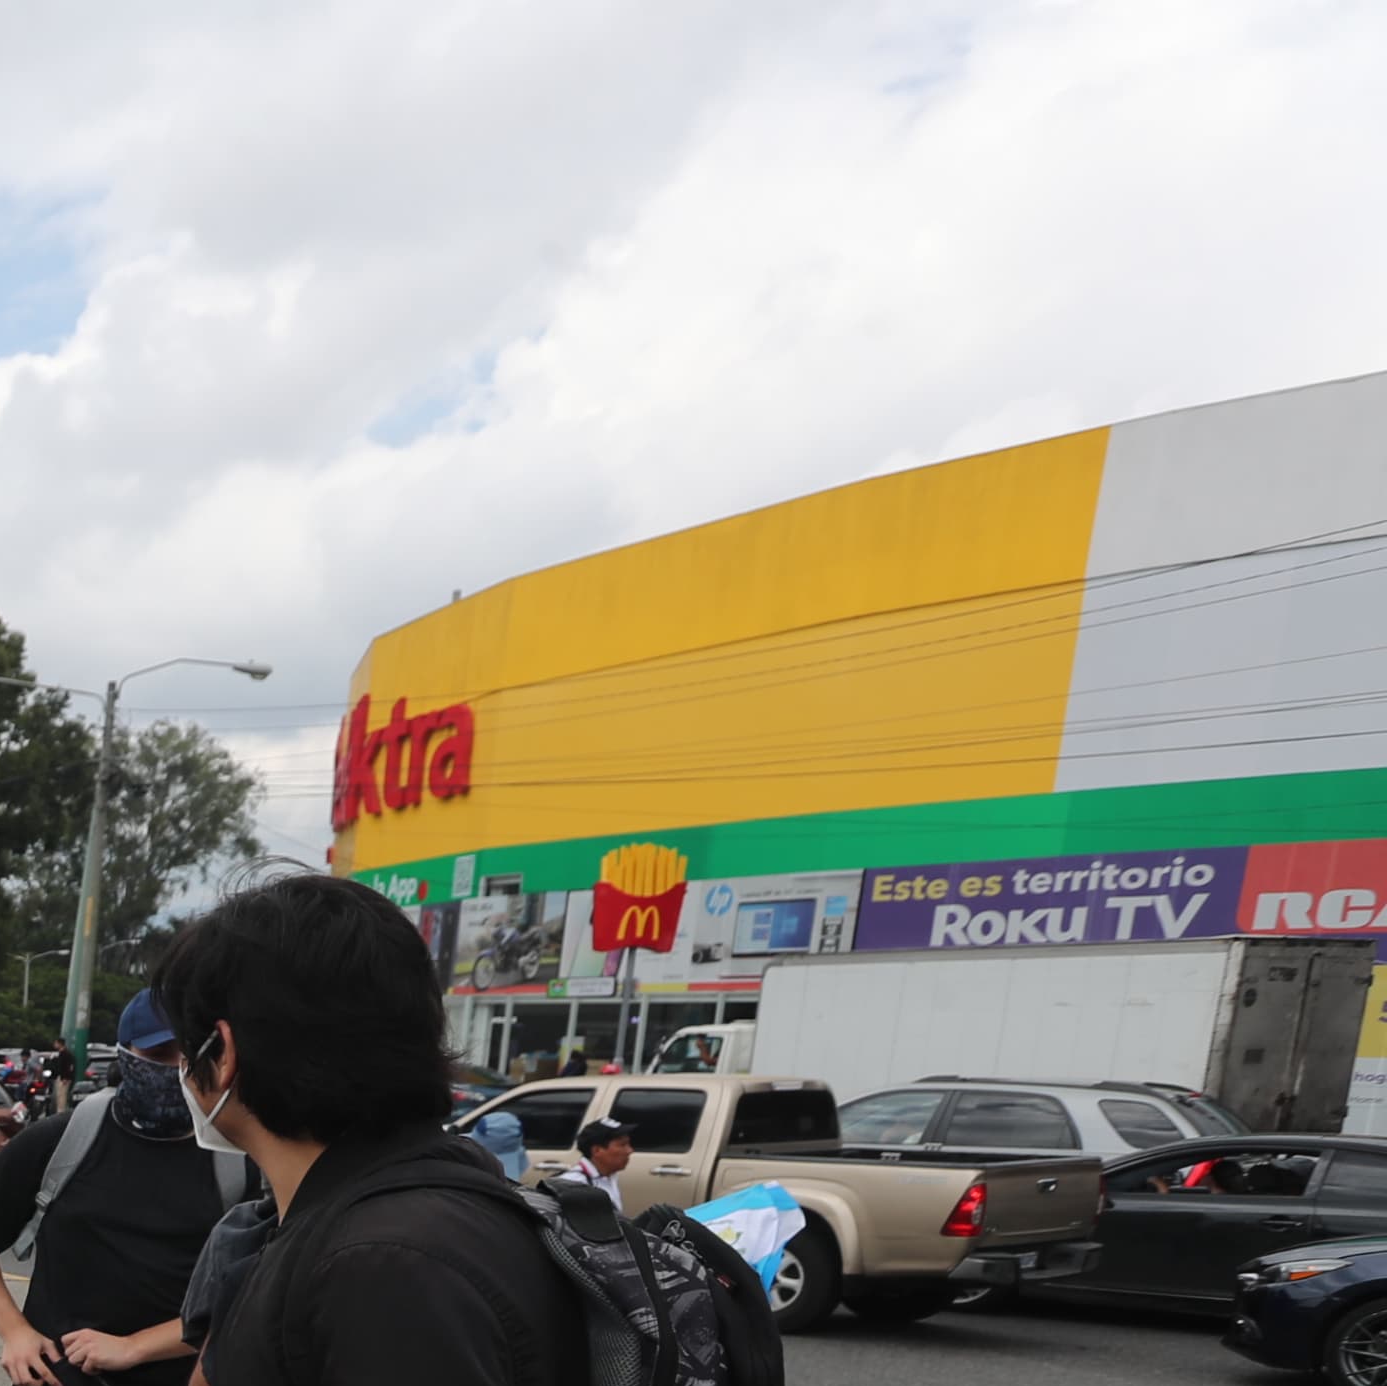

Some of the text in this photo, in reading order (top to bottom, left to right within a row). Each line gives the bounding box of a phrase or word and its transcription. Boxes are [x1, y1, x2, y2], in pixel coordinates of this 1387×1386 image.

[872, 856, 1215, 902] Este es territorio
[1105, 893, 1211, 942] TV
